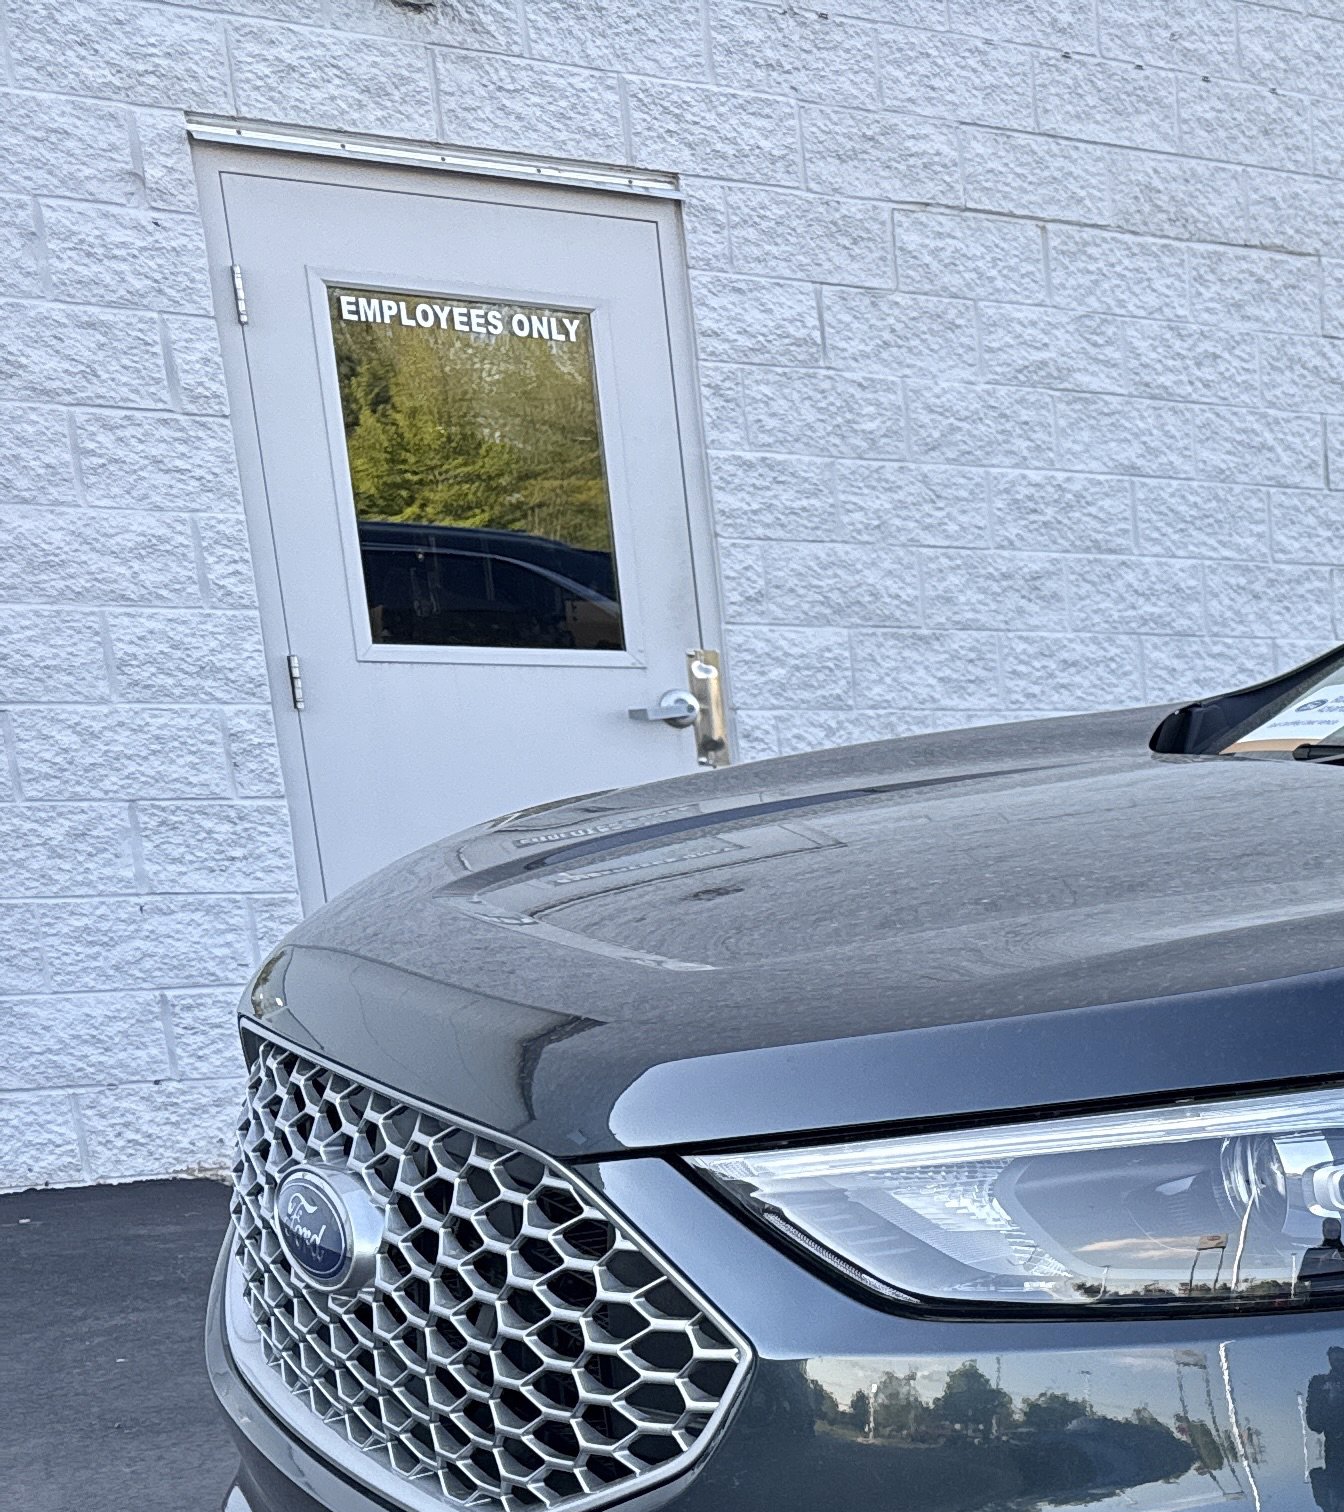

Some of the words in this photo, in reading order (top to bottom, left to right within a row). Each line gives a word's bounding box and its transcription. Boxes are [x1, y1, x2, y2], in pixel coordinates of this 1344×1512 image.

[339, 296, 503, 335] EMPLOYEES
[511, 314, 580, 342] ONLY
[287, 1192, 327, 1246] Ford
